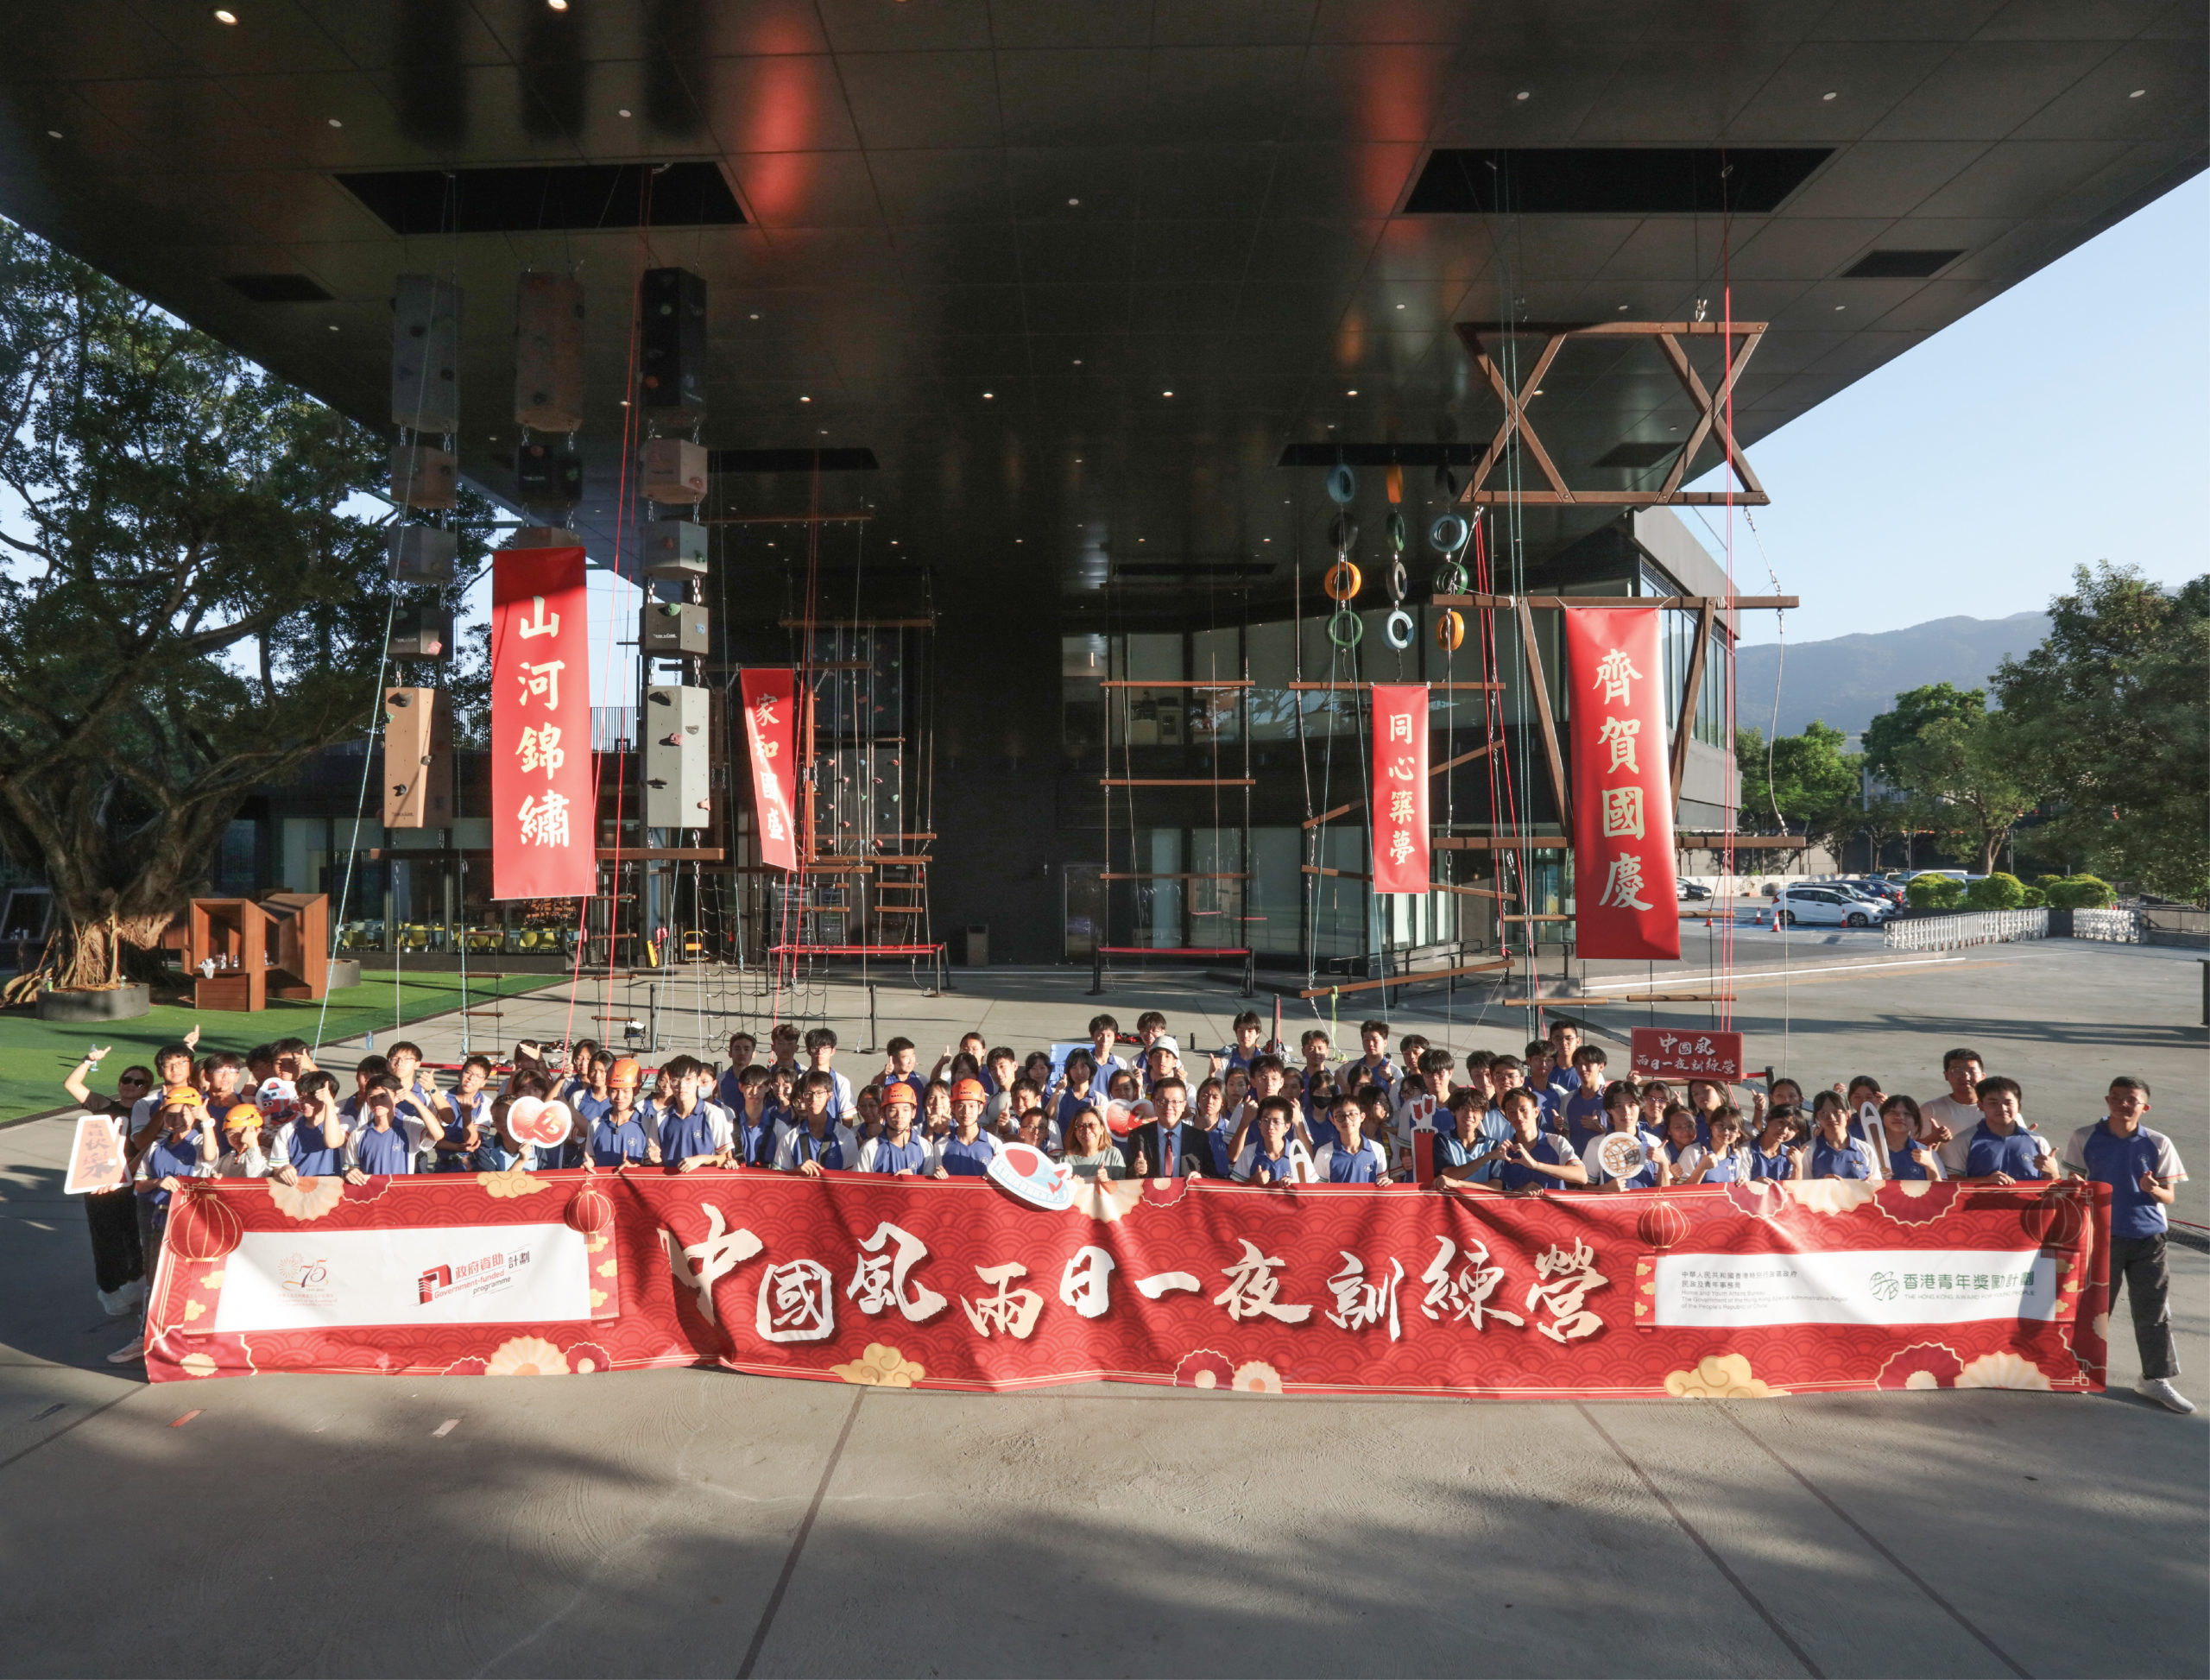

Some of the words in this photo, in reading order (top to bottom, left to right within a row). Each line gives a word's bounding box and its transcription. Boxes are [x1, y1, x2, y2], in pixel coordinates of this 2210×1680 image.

[515, 595, 571, 849] 山河錦繡
[1388, 714, 1416, 866] 同心築夢
[1593, 648, 1653, 912] 齊賀國慶
[1658, 1033, 1715, 1056] 中國風
[541, 1111, 562, 1135] 75
[300, 1258, 327, 1288] 75
[455, 1253, 504, 1279] 政府資助
[508, 1251, 530, 1269] 計劃
[434, 1270, 505, 1299] Government-funded
[472, 1277, 511, 1295] programme
[1903, 1271, 2035, 1291] 香港青年獎勵計劃
